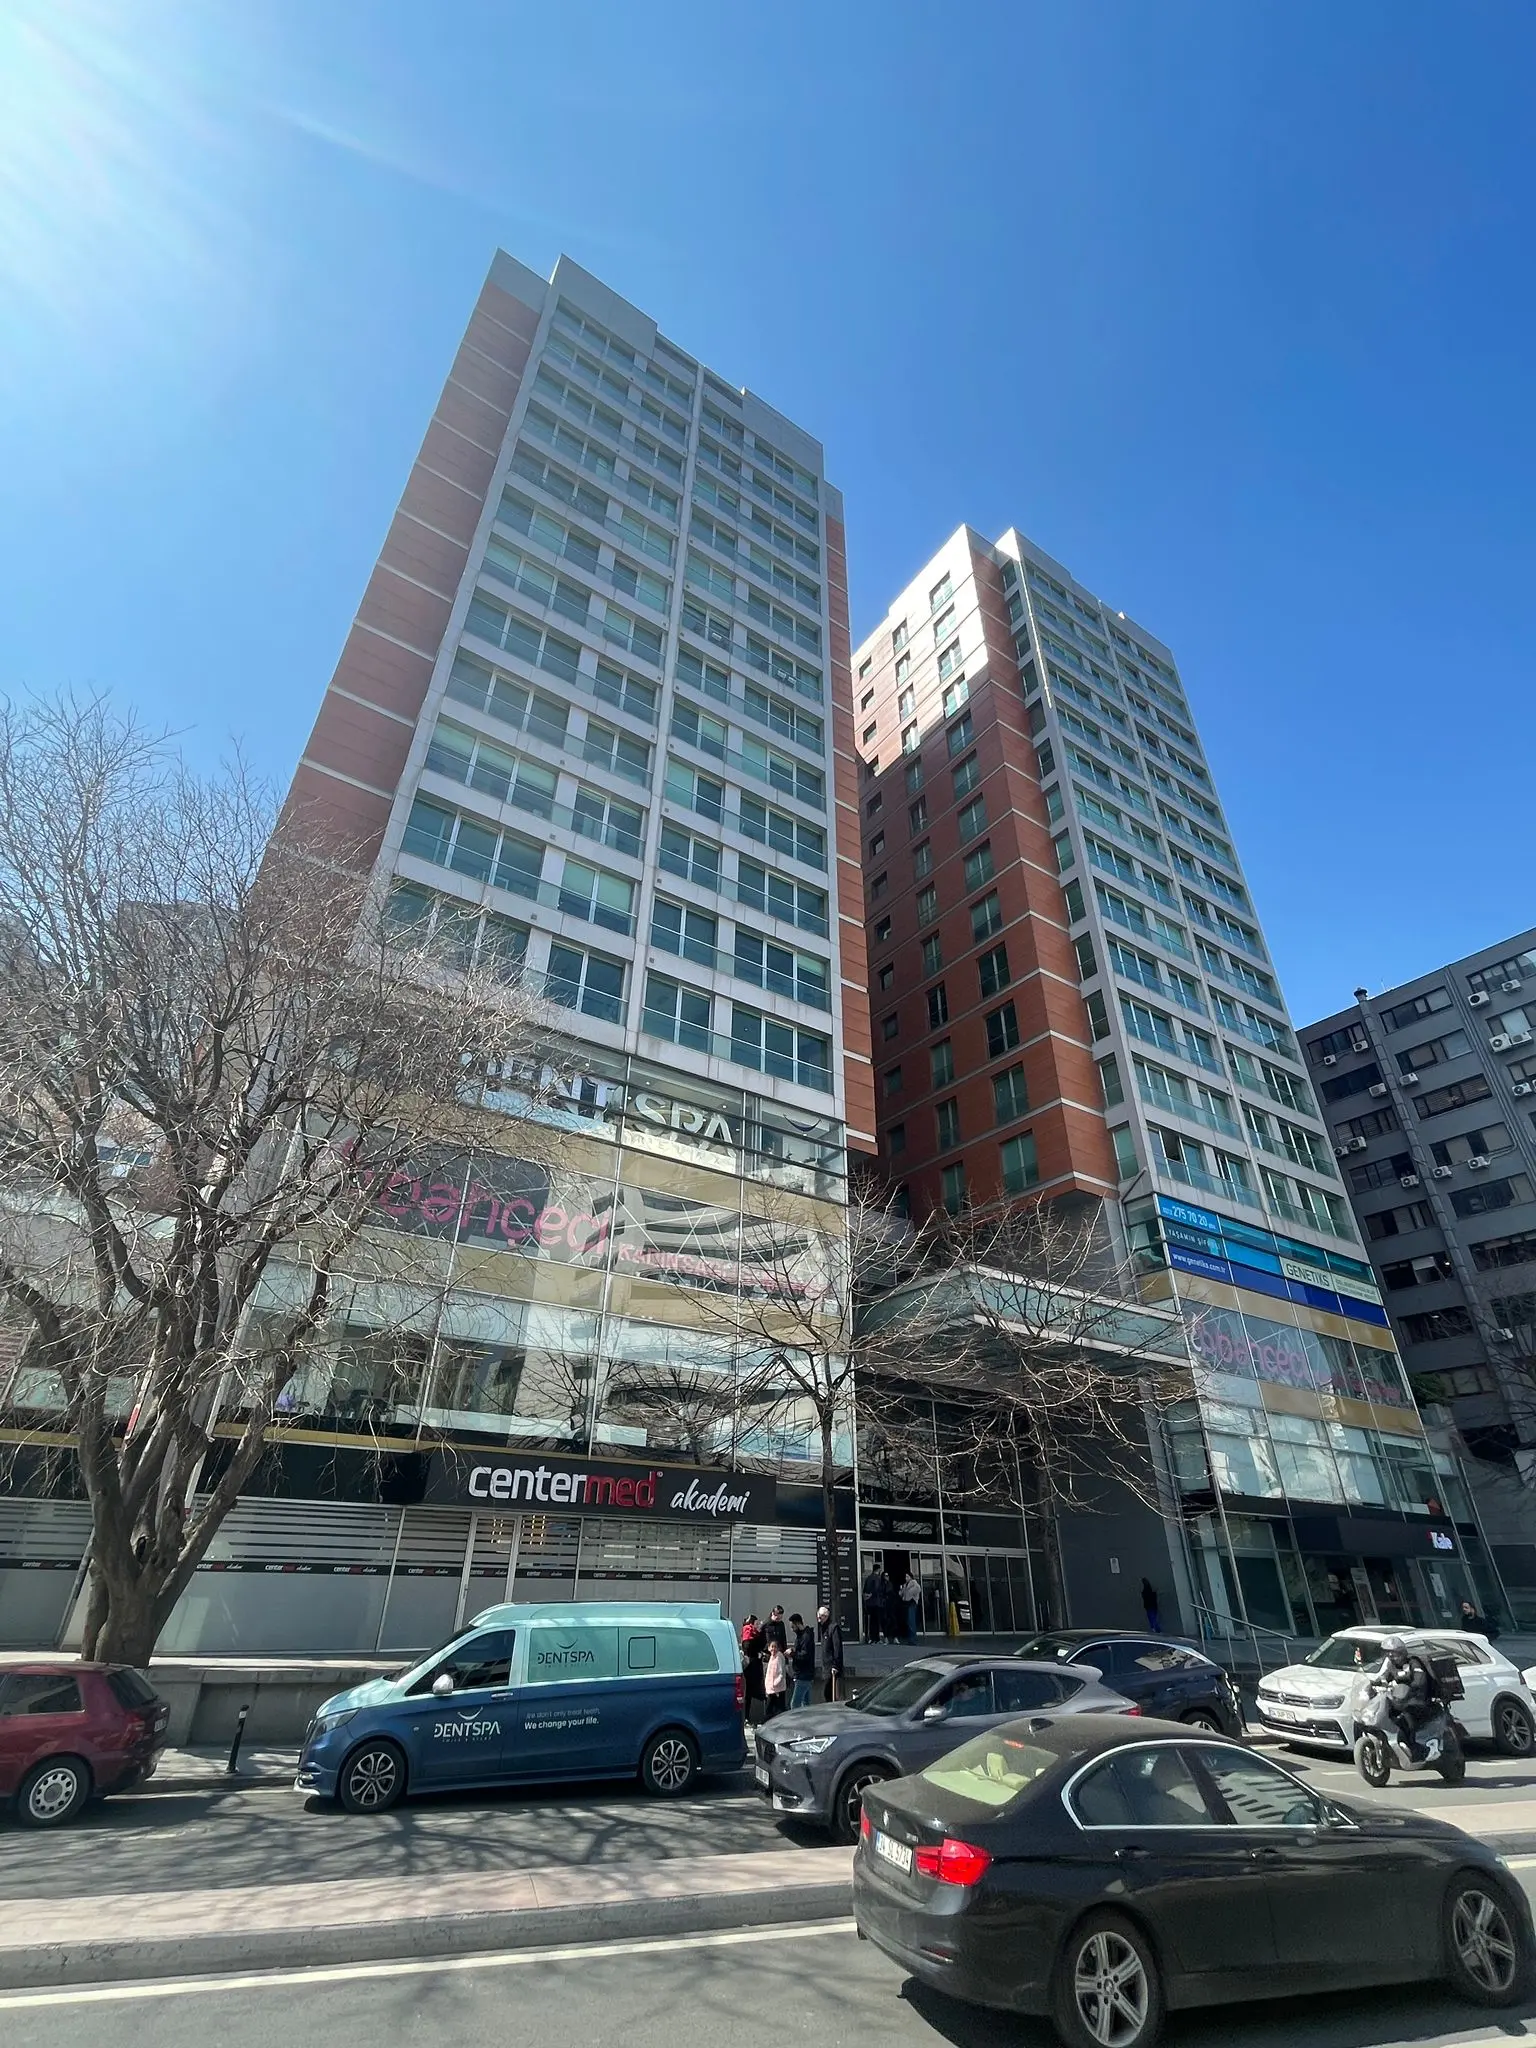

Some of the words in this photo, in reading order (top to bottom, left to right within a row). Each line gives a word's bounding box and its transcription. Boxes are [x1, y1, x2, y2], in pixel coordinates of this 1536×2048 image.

[632, 1093, 737, 1158] SPA
[1172, 1206, 1187, 1220] 275
[1187, 1211, 1197, 1223] 70
[1198, 1215, 1208, 1227] 20
[468, 1465, 657, 1508] centermed
[670, 1478, 750, 1517] akademi
[537, 1650, 595, 1665] DENTSPA
[433, 1721, 501, 1738] DENTSPA
[524, 1721, 537, 1730] We
[538, 1720, 567, 1729] change
[568, 1718, 585, 1728] your
[585, 1716, 599, 1725] life.
